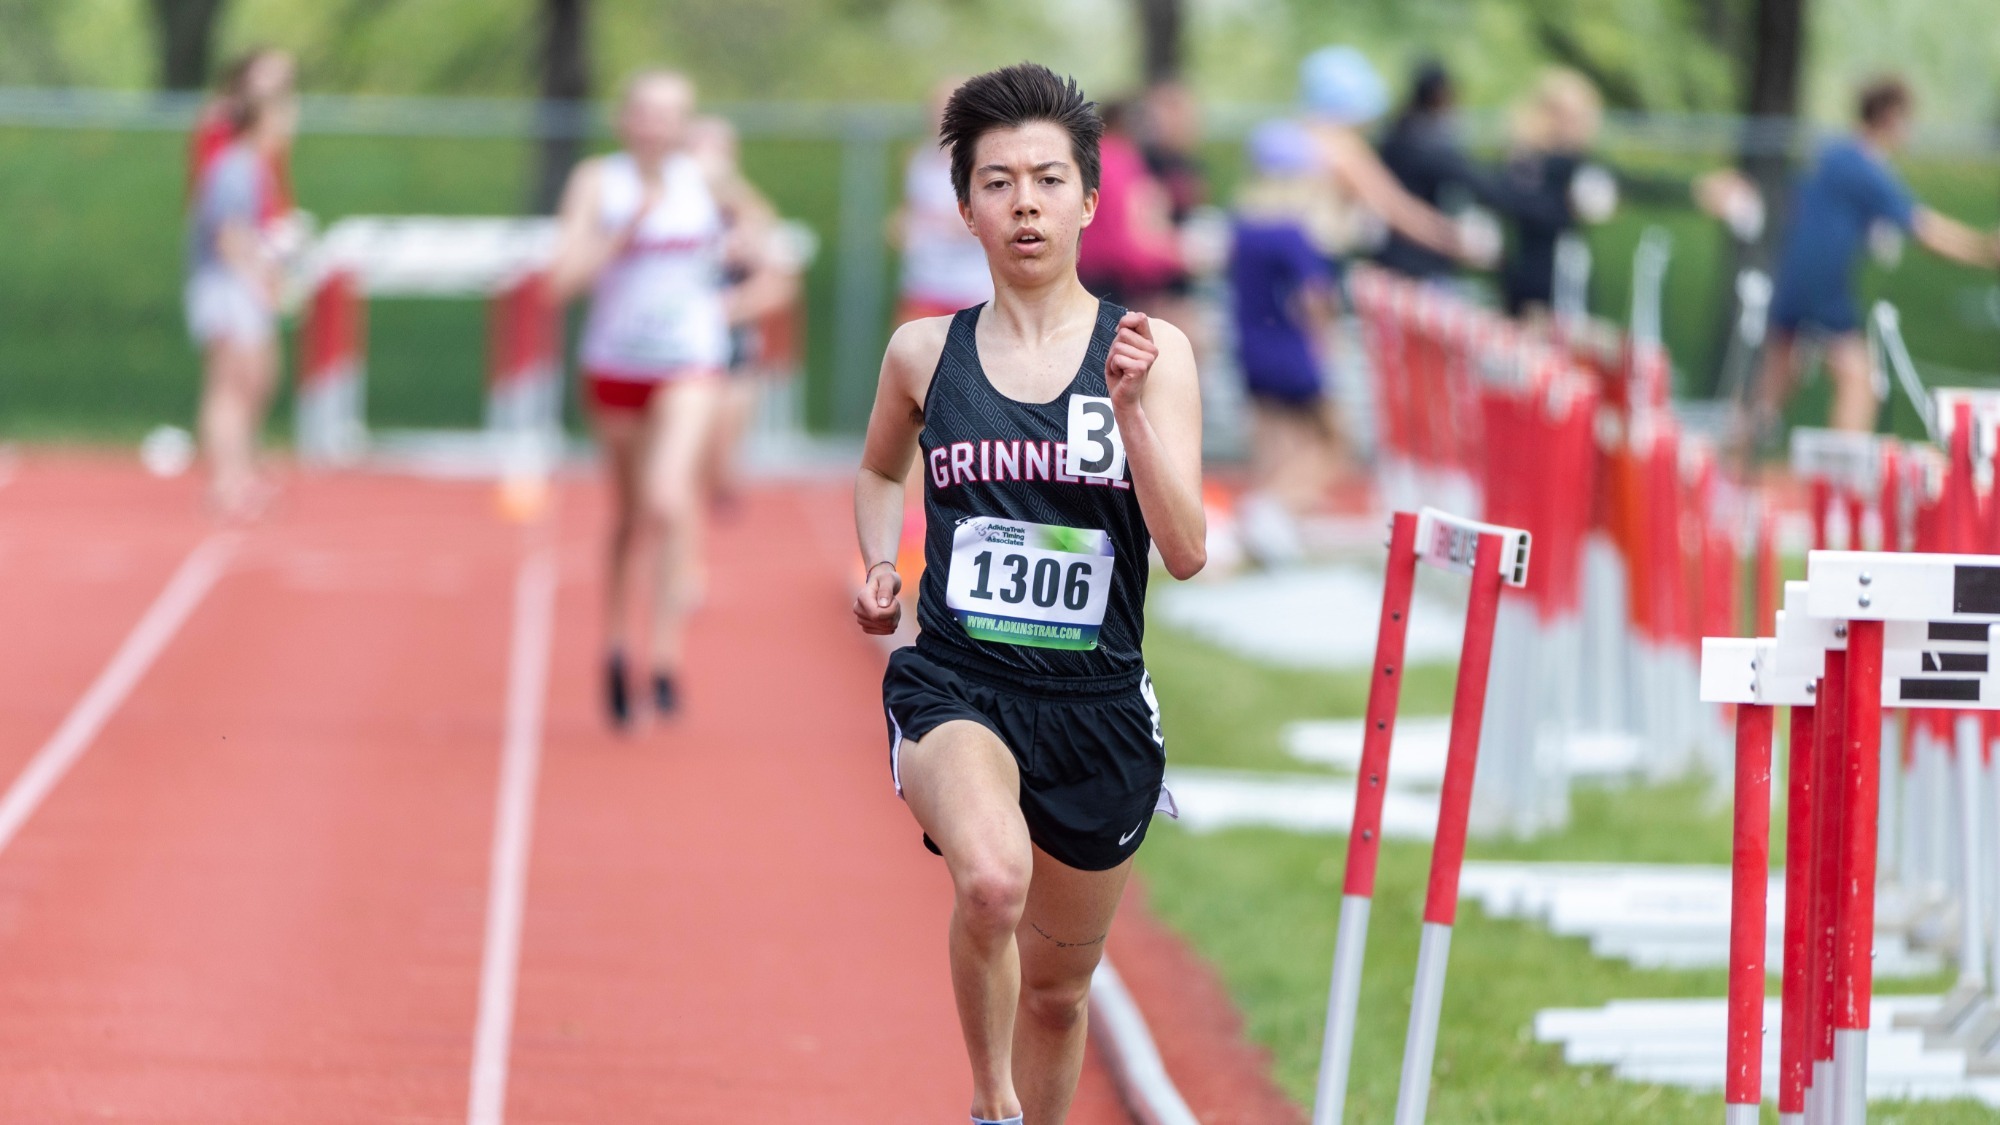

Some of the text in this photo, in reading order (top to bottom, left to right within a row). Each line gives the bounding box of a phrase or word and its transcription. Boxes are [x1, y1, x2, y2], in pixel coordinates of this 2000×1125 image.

[1079, 401, 1115, 474] 3
[929, 440, 1131, 490] GRINNE
[986, 536, 1024, 546] Associates
[987, 523, 1026, 534] AdkinsTrak
[1002, 531, 1025, 541] Timing
[969, 550, 1092, 611] 1306
[967, 615, 1082, 640] WWW.ADKINSTRAK.COM
